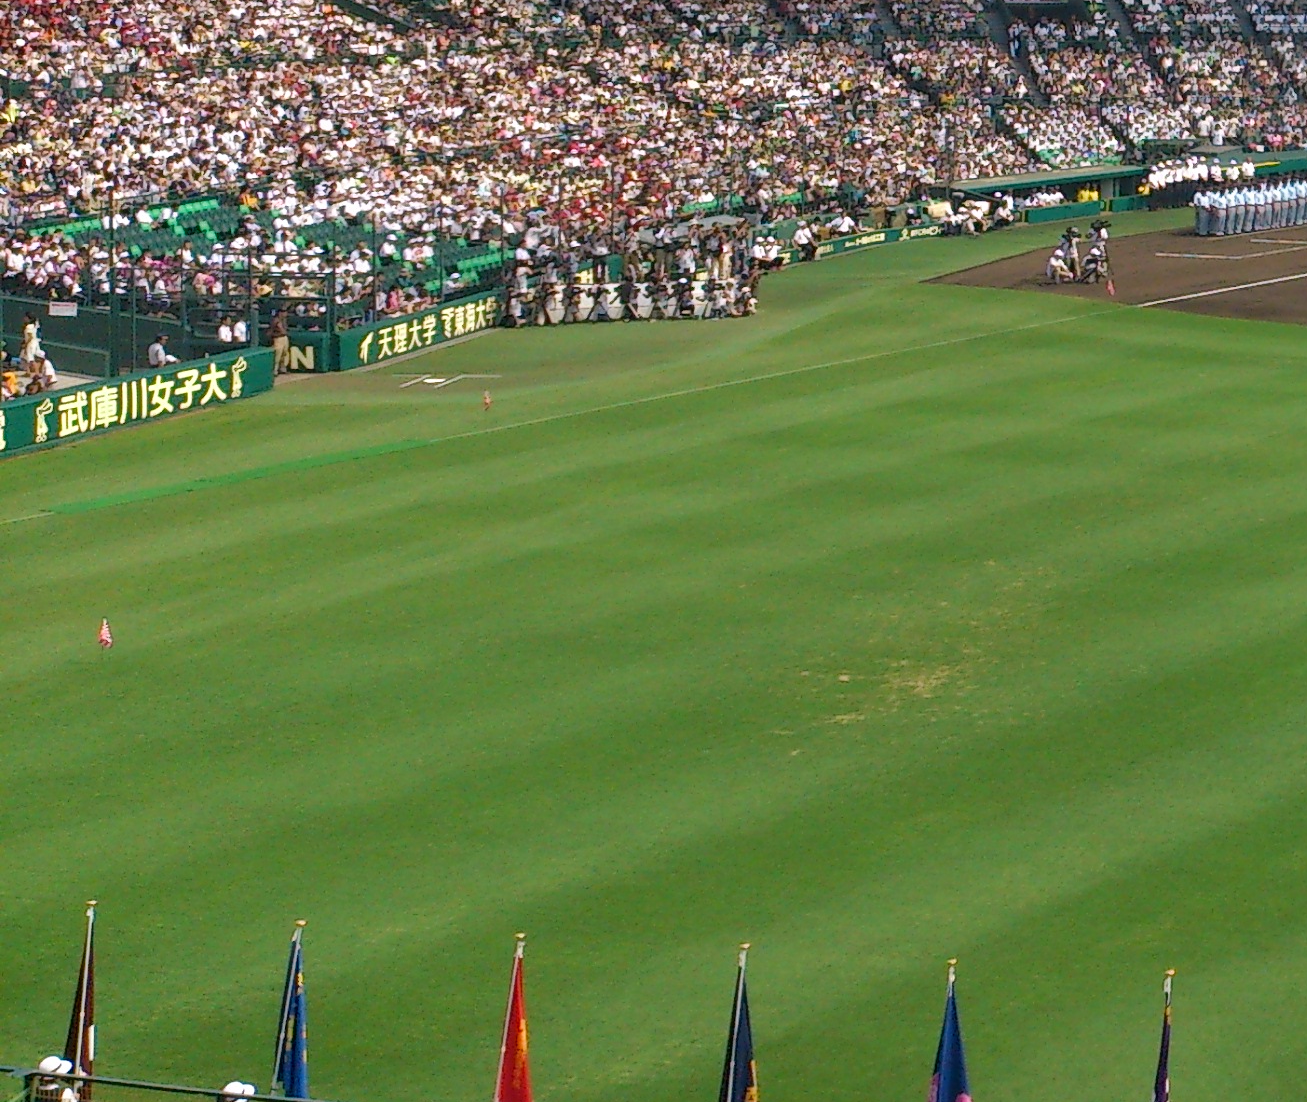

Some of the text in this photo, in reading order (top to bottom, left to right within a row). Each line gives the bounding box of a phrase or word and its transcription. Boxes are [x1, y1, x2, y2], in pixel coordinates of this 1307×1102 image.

[378, 314, 436, 360] 天理大学
[58, 363, 227, 438] 武庫川女子大
